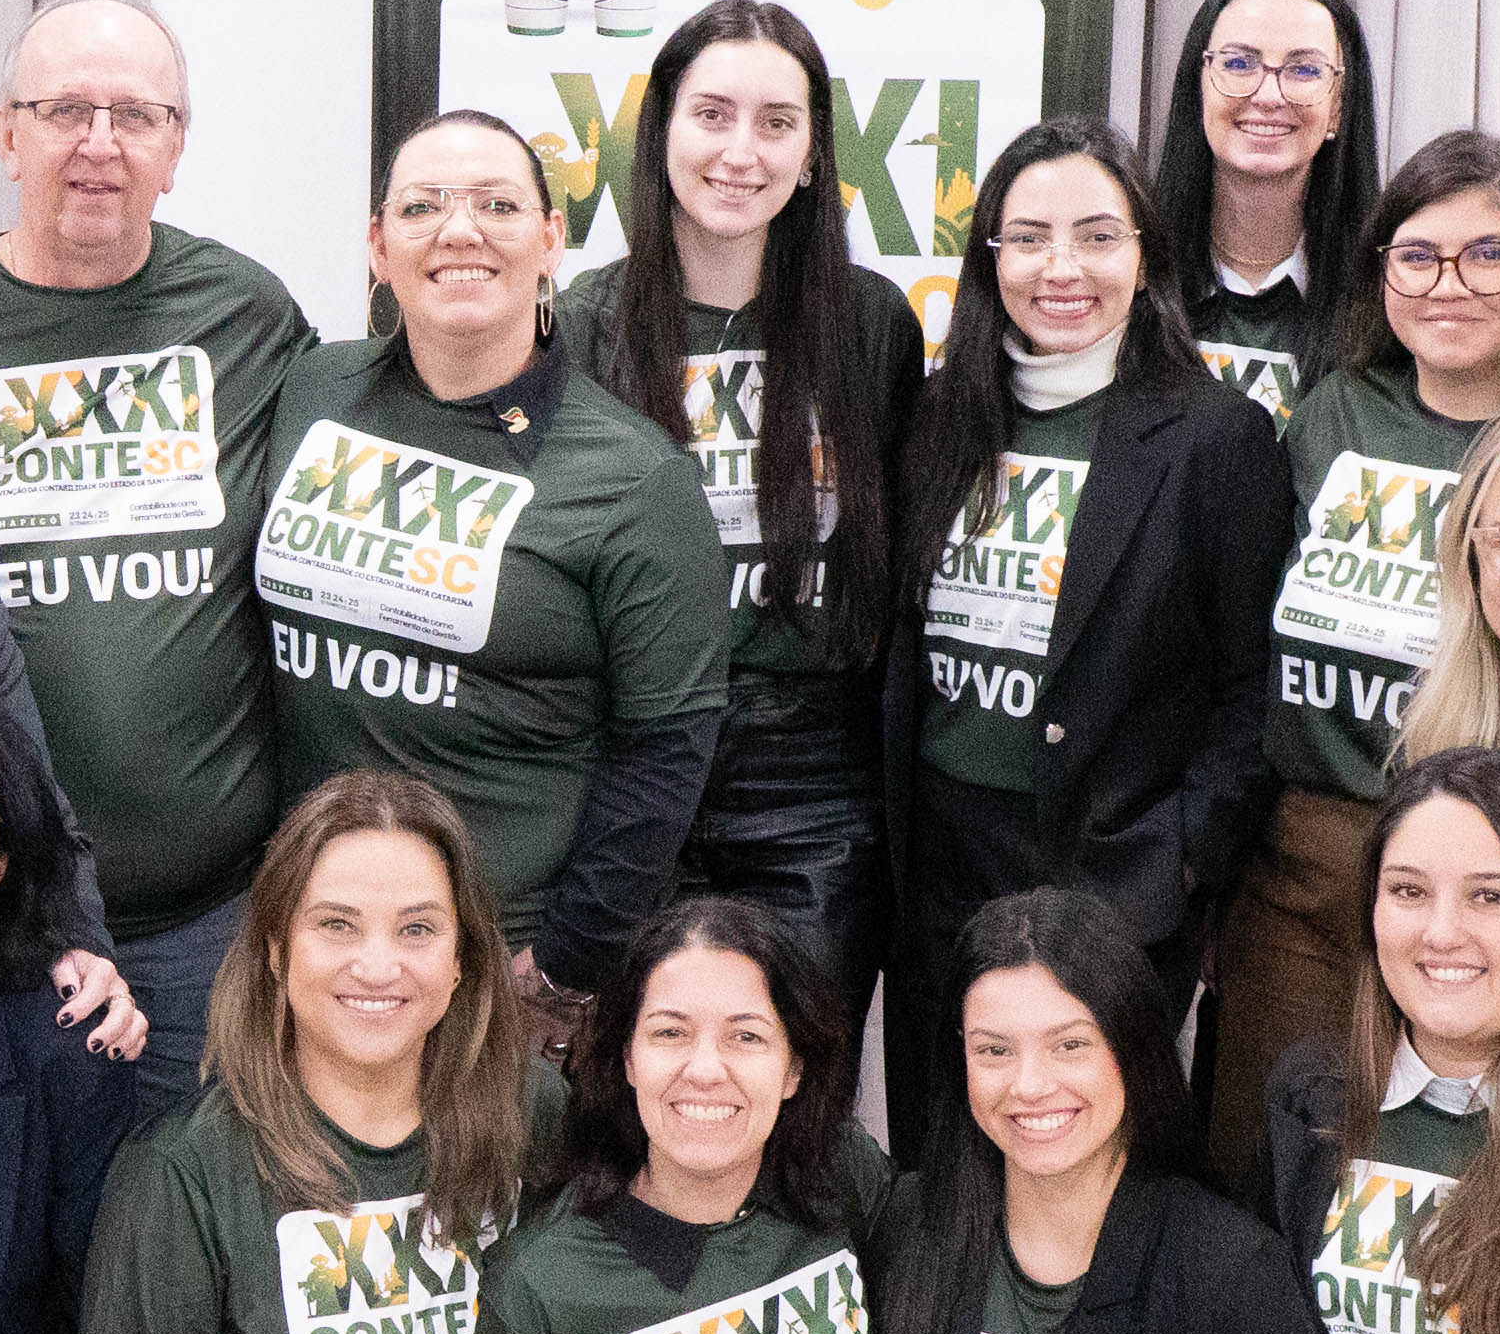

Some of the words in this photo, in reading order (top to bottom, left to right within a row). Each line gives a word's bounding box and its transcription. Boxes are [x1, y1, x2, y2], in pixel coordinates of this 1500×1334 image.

[286, 436, 518, 549] XXXI
[80, 547, 214, 603] VOU!
[267, 507, 480, 594] CONTESC
[1303, 547, 1440, 607] CONTE
[272, 619, 317, 679] EU
[327, 637, 459, 708] VOU!
[1280, 654, 1338, 709] EU
